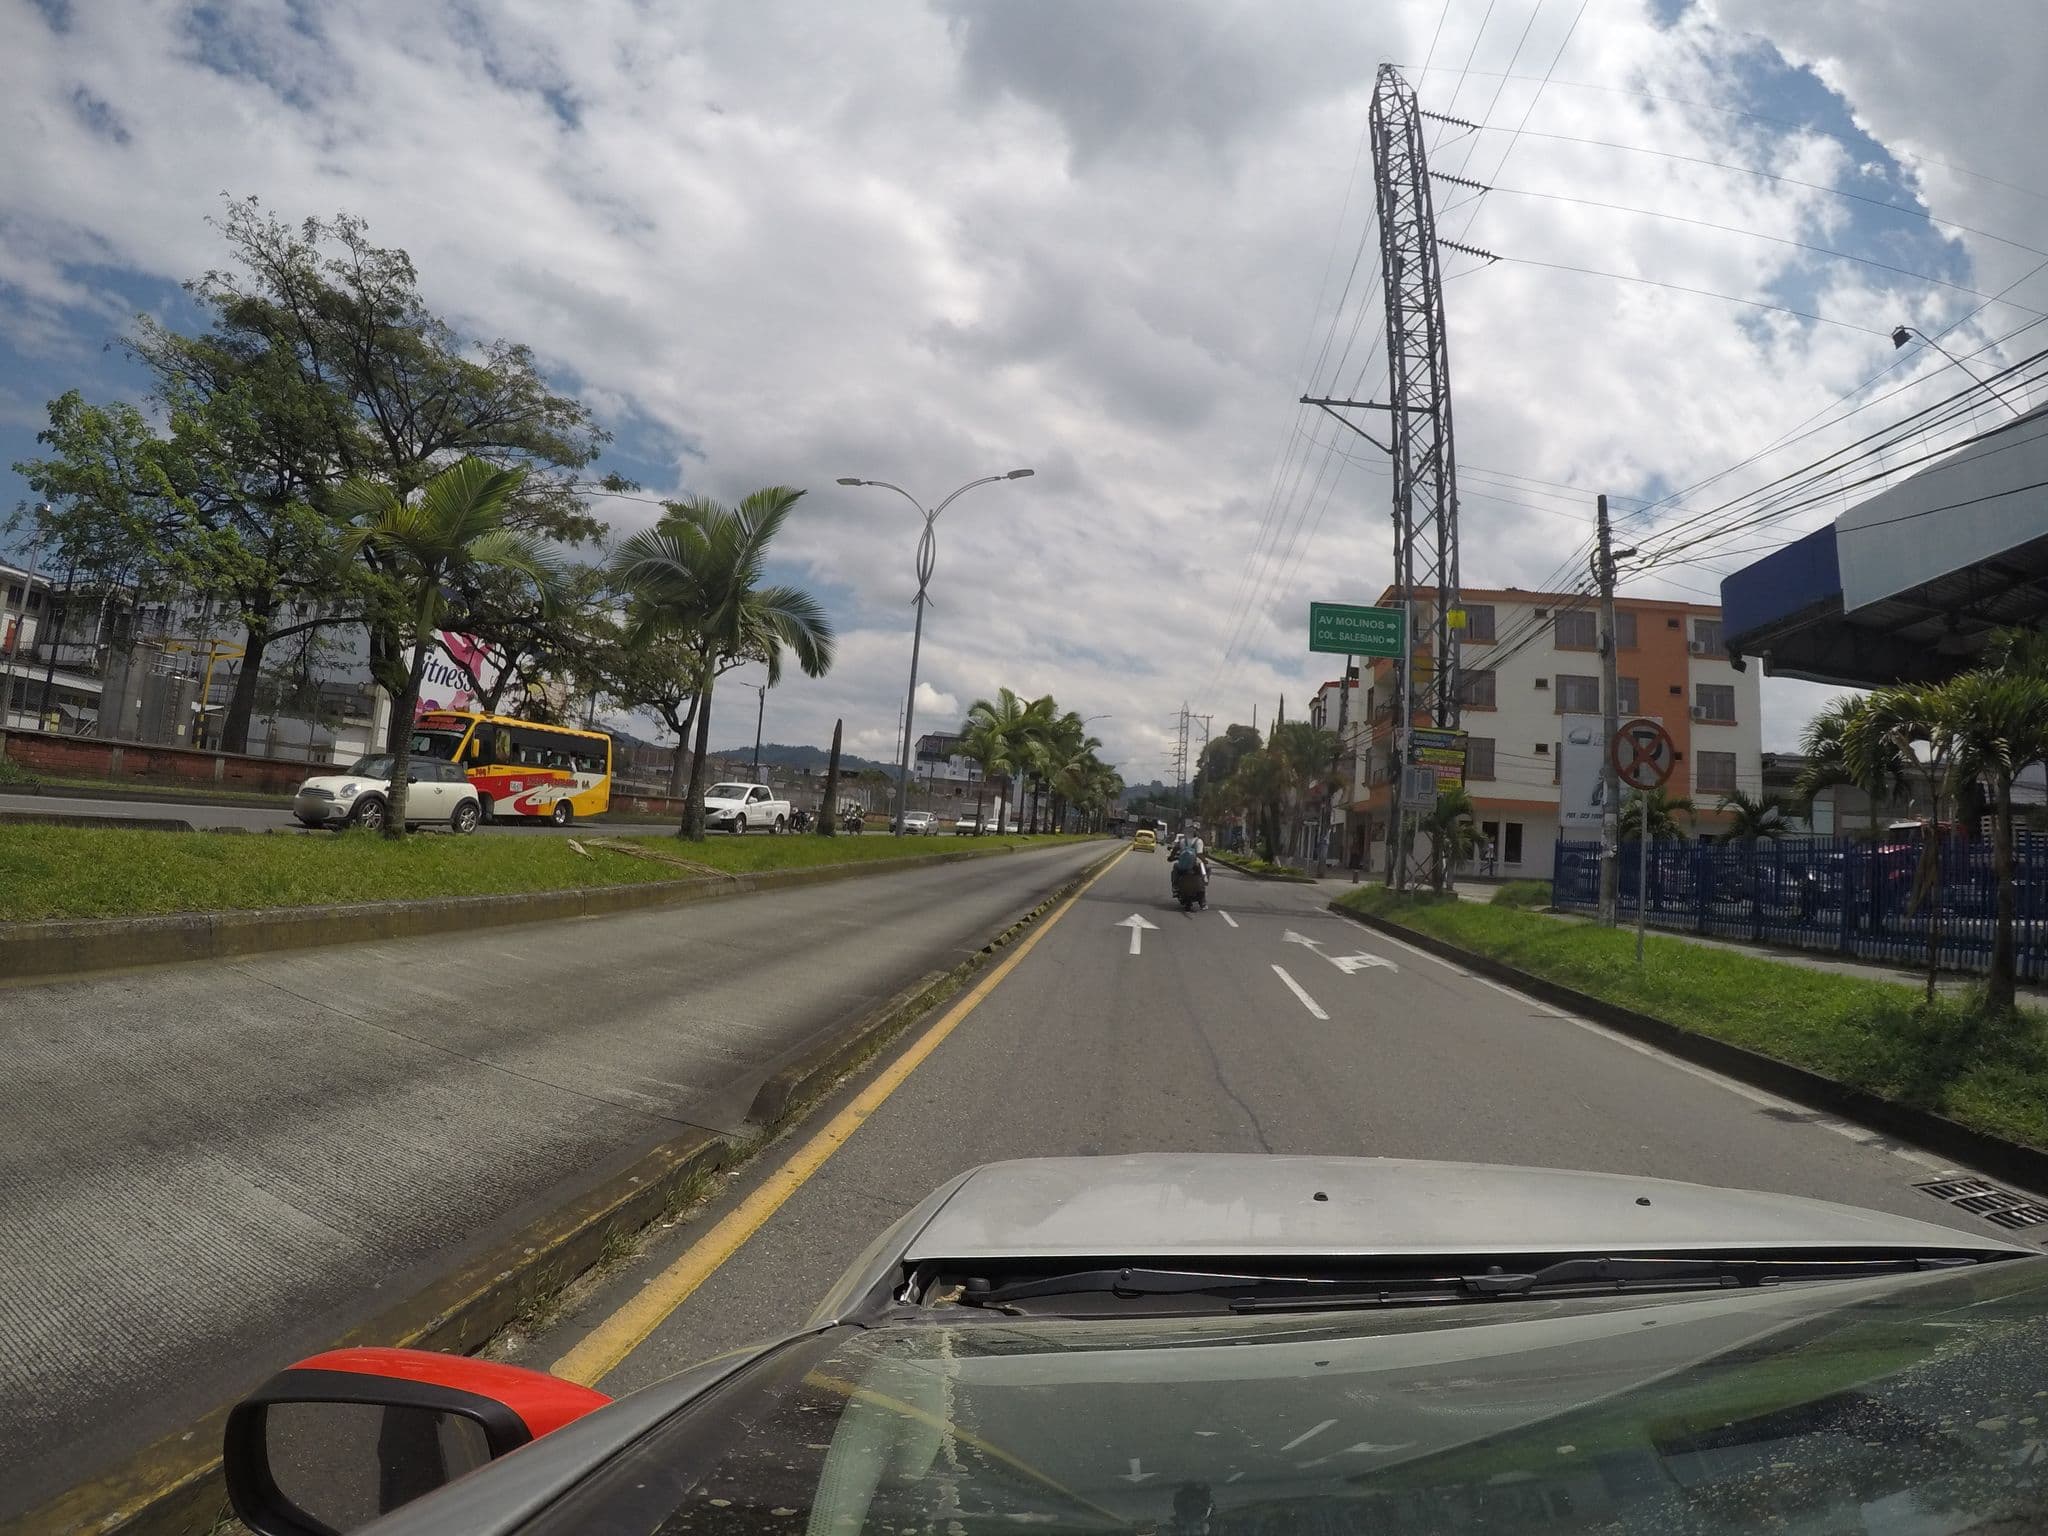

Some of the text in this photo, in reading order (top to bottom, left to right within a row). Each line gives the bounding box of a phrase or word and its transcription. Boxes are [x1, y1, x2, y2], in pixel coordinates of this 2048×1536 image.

[1318, 615, 1385, 630] AV MOLINOS
[1339, 632, 1385, 644] SALESIANO
[420, 654, 473, 692] itness
